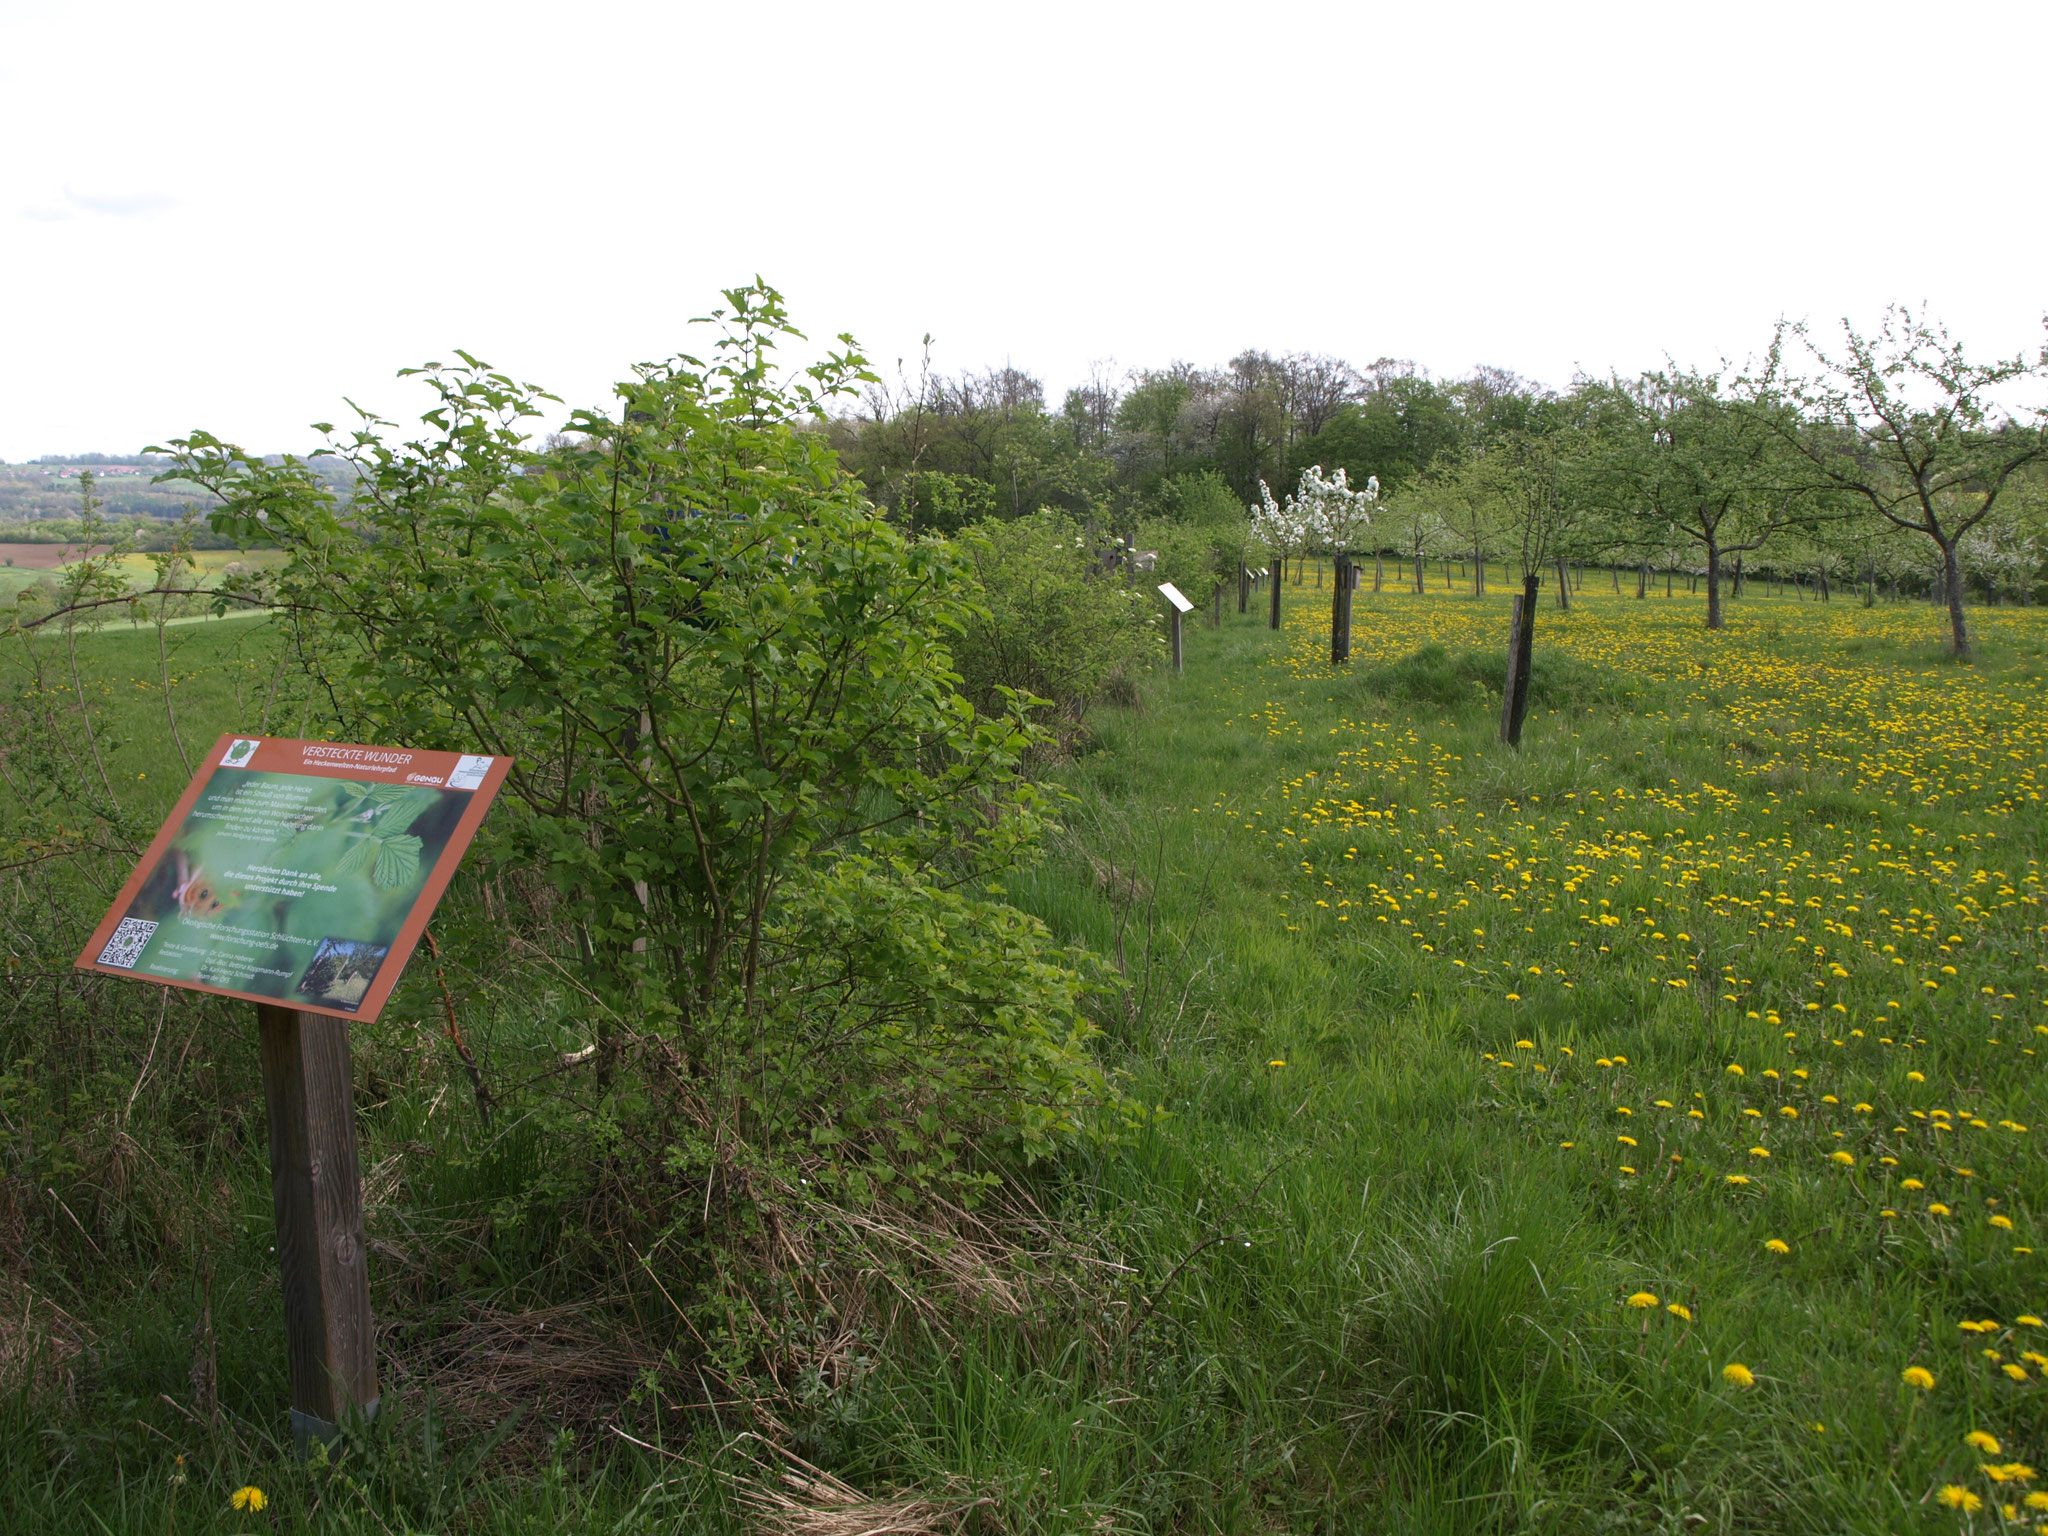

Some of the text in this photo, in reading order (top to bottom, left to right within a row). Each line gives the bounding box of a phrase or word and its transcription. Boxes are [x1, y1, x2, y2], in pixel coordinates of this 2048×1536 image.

[302, 746, 412, 764] VERSTECKTE WUNDER
[313, 760, 398, 774] Heckenwelten-Naturlehrpfad
[248, 865, 280, 874] Herzlichen
[255, 875, 278, 884] Projekt
[312, 883, 337, 892] Spende
[245, 885, 305, 897] unterstützt haben!
[182, 918, 216, 929] Ökologische
[217, 924, 269, 937] Forschungsstation
[271, 933, 306, 943] Schlüchtern
[211, 934, 278, 949] www.forschung-oefs.de
[235, 971, 254, 979] Schmidt
